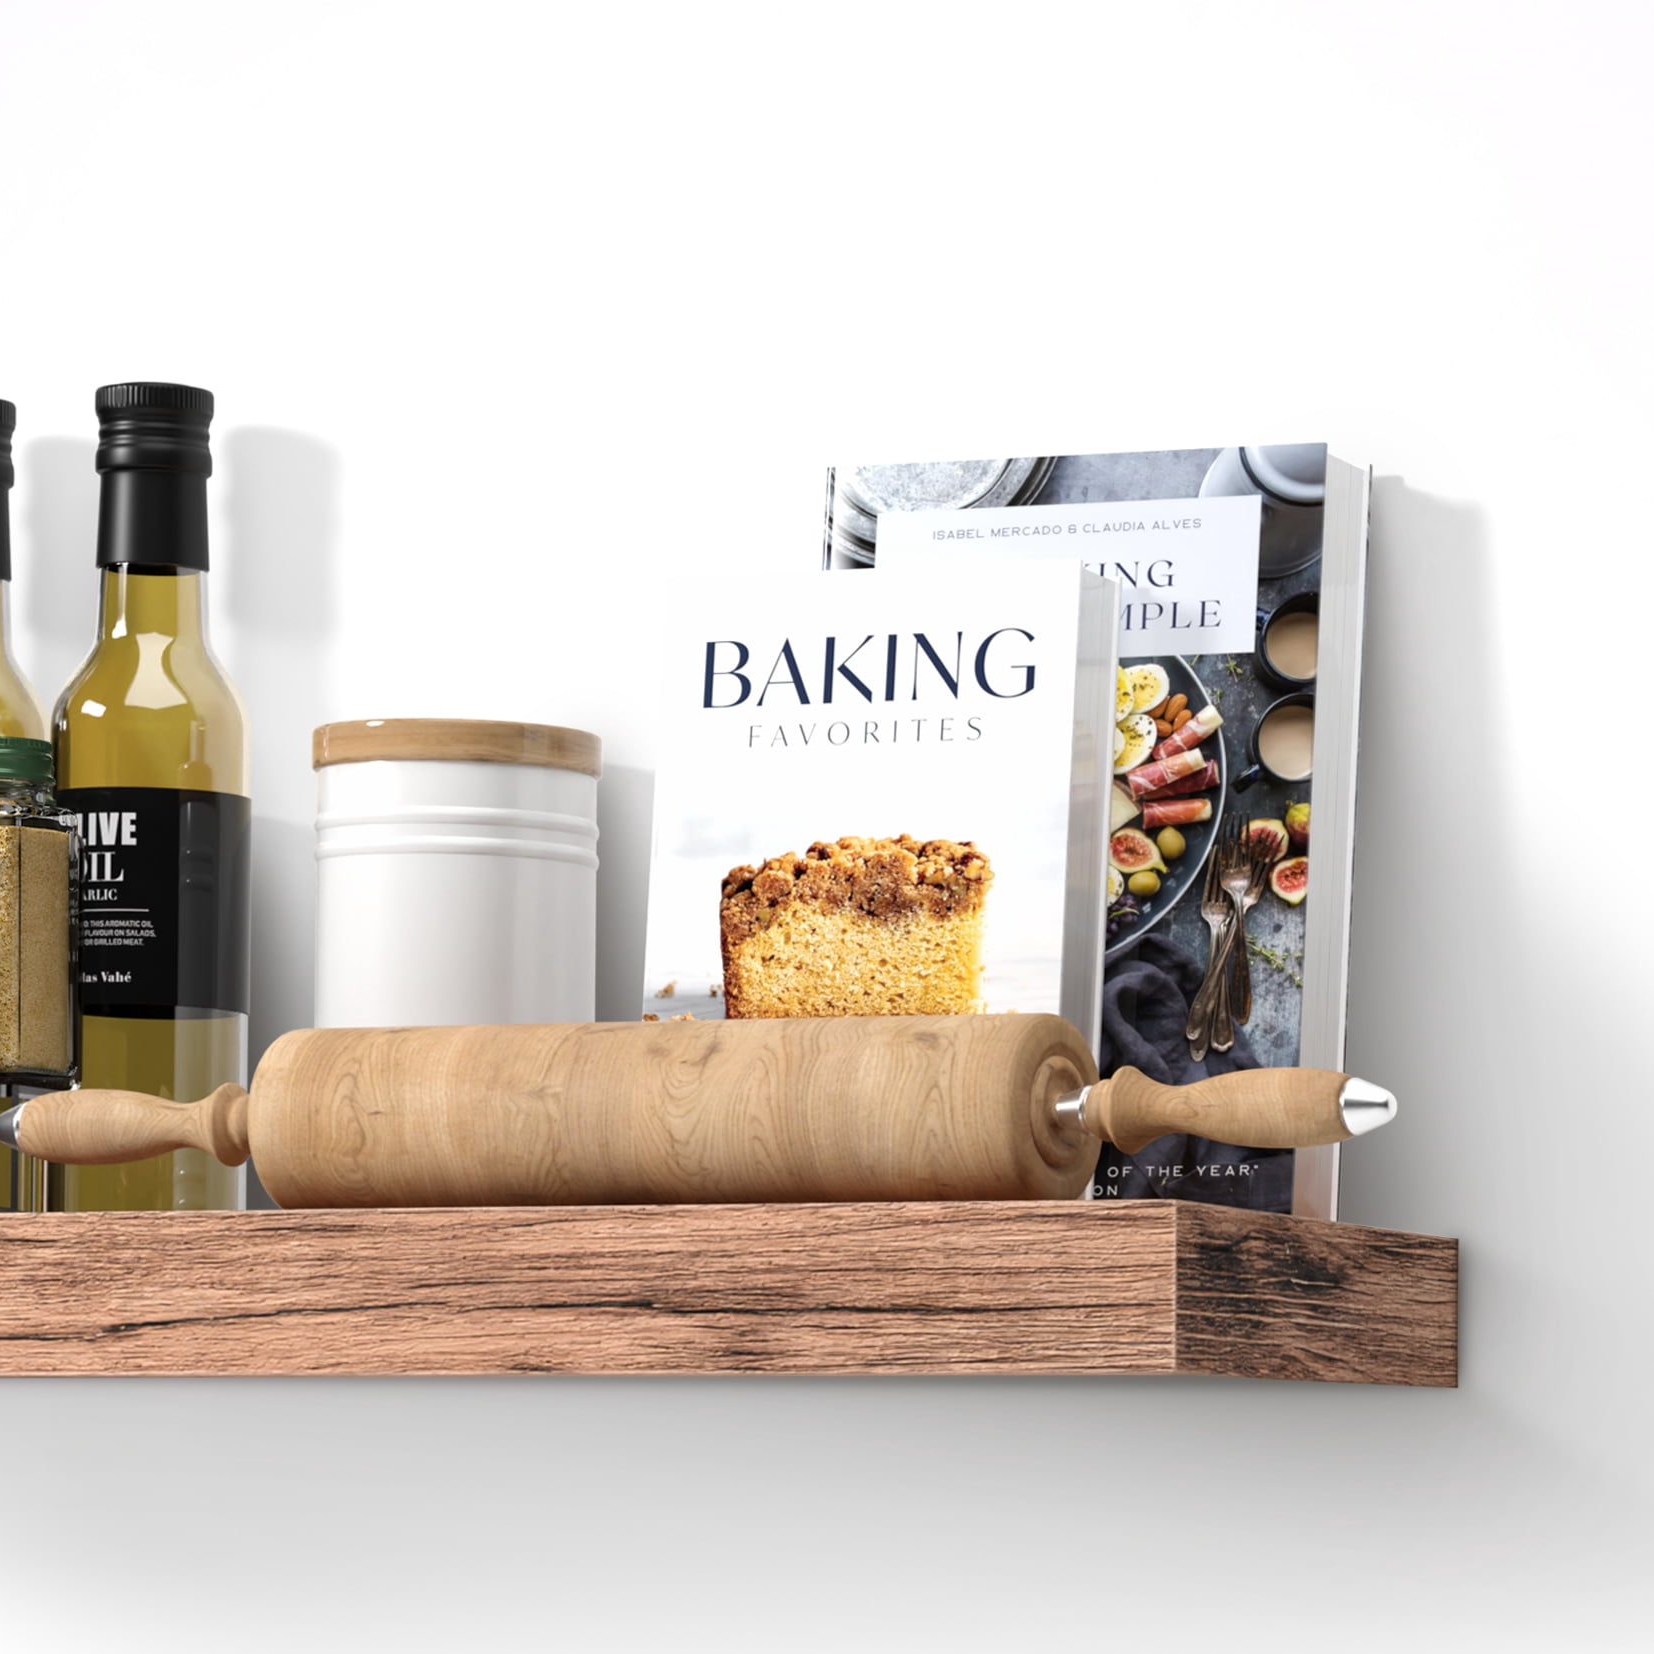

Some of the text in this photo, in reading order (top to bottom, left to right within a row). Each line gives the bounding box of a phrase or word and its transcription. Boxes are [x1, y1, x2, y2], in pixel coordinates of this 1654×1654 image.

[932, 518, 1203, 541] ISABEL MERCADO & CLAUDIA ALVES
[703, 627, 1036, 709] BAKING
[747, 716, 983, 748] FAVORITES
[77, 811, 138, 847] LIVE
[1107, 1166, 1133, 1178] OF
[1146, 1165, 1184, 1177] THE
